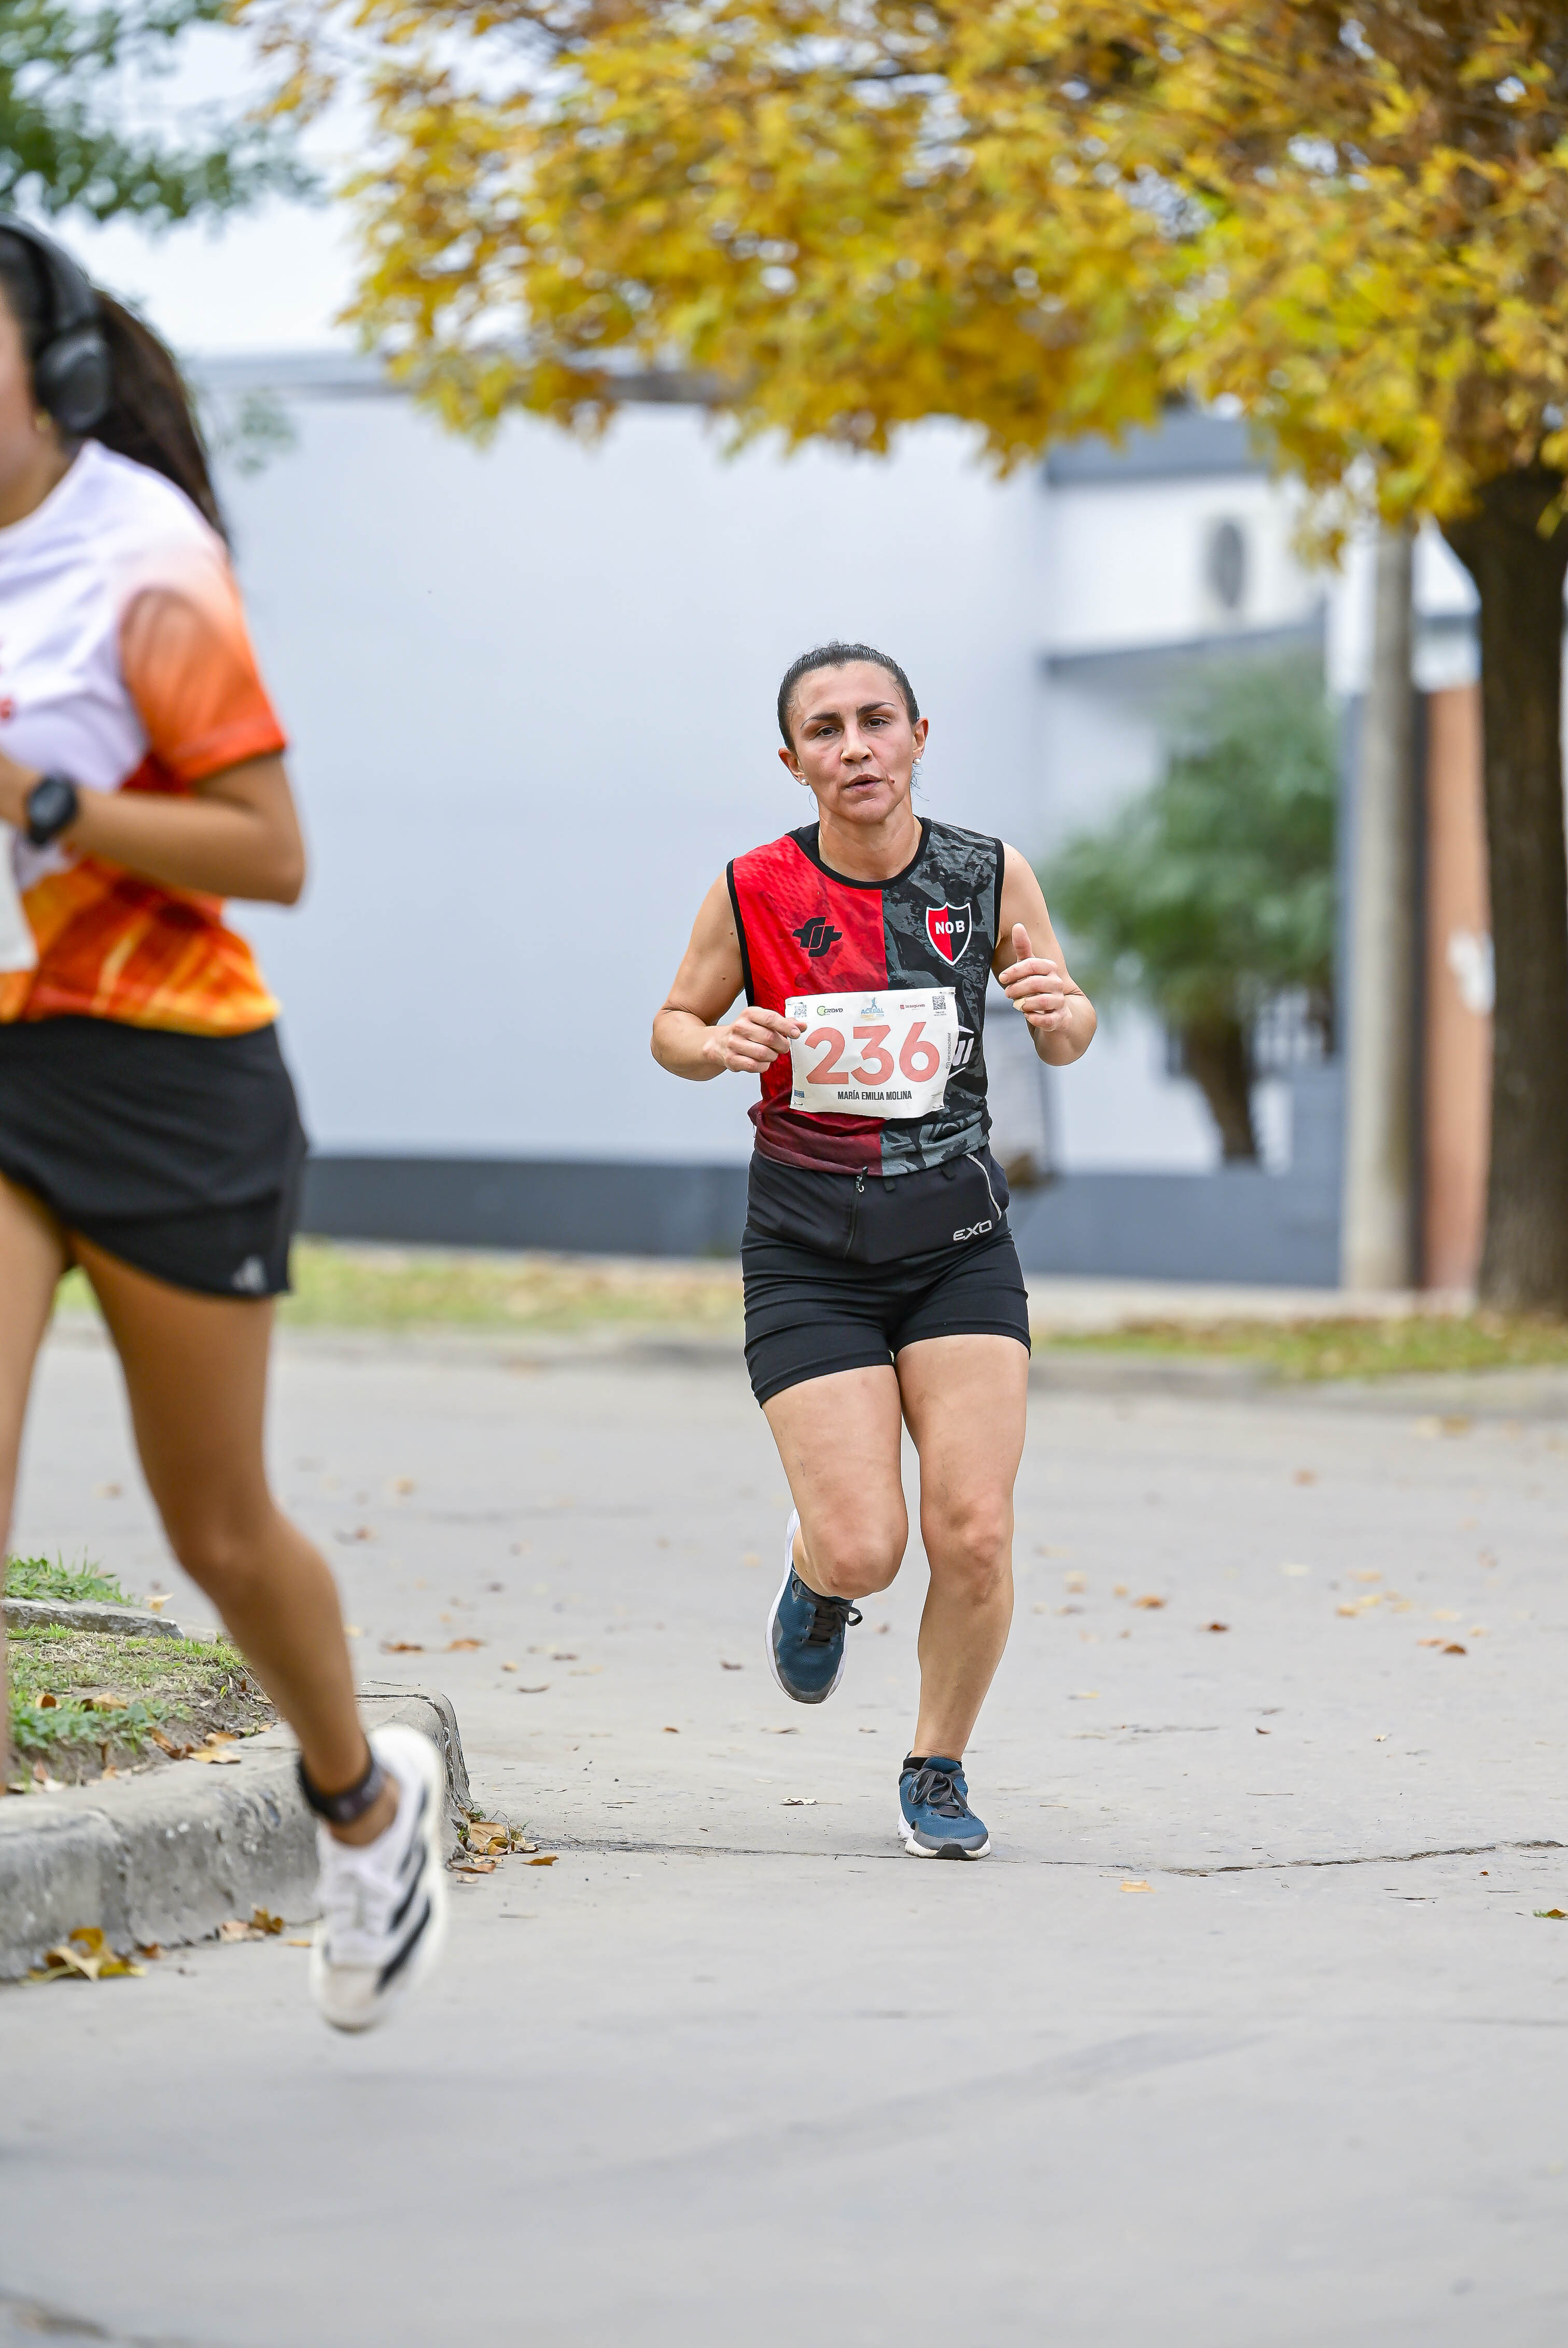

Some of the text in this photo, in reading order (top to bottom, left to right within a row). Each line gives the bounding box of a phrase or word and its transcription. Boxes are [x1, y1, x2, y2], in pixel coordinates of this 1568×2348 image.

[935, 920, 965, 934] NOB
[804, 1022, 940, 1086] 236
[837, 1090, 912, 1100] MARÍA EMILIA MOLINA
[953, 1220, 992, 1241] EXO
